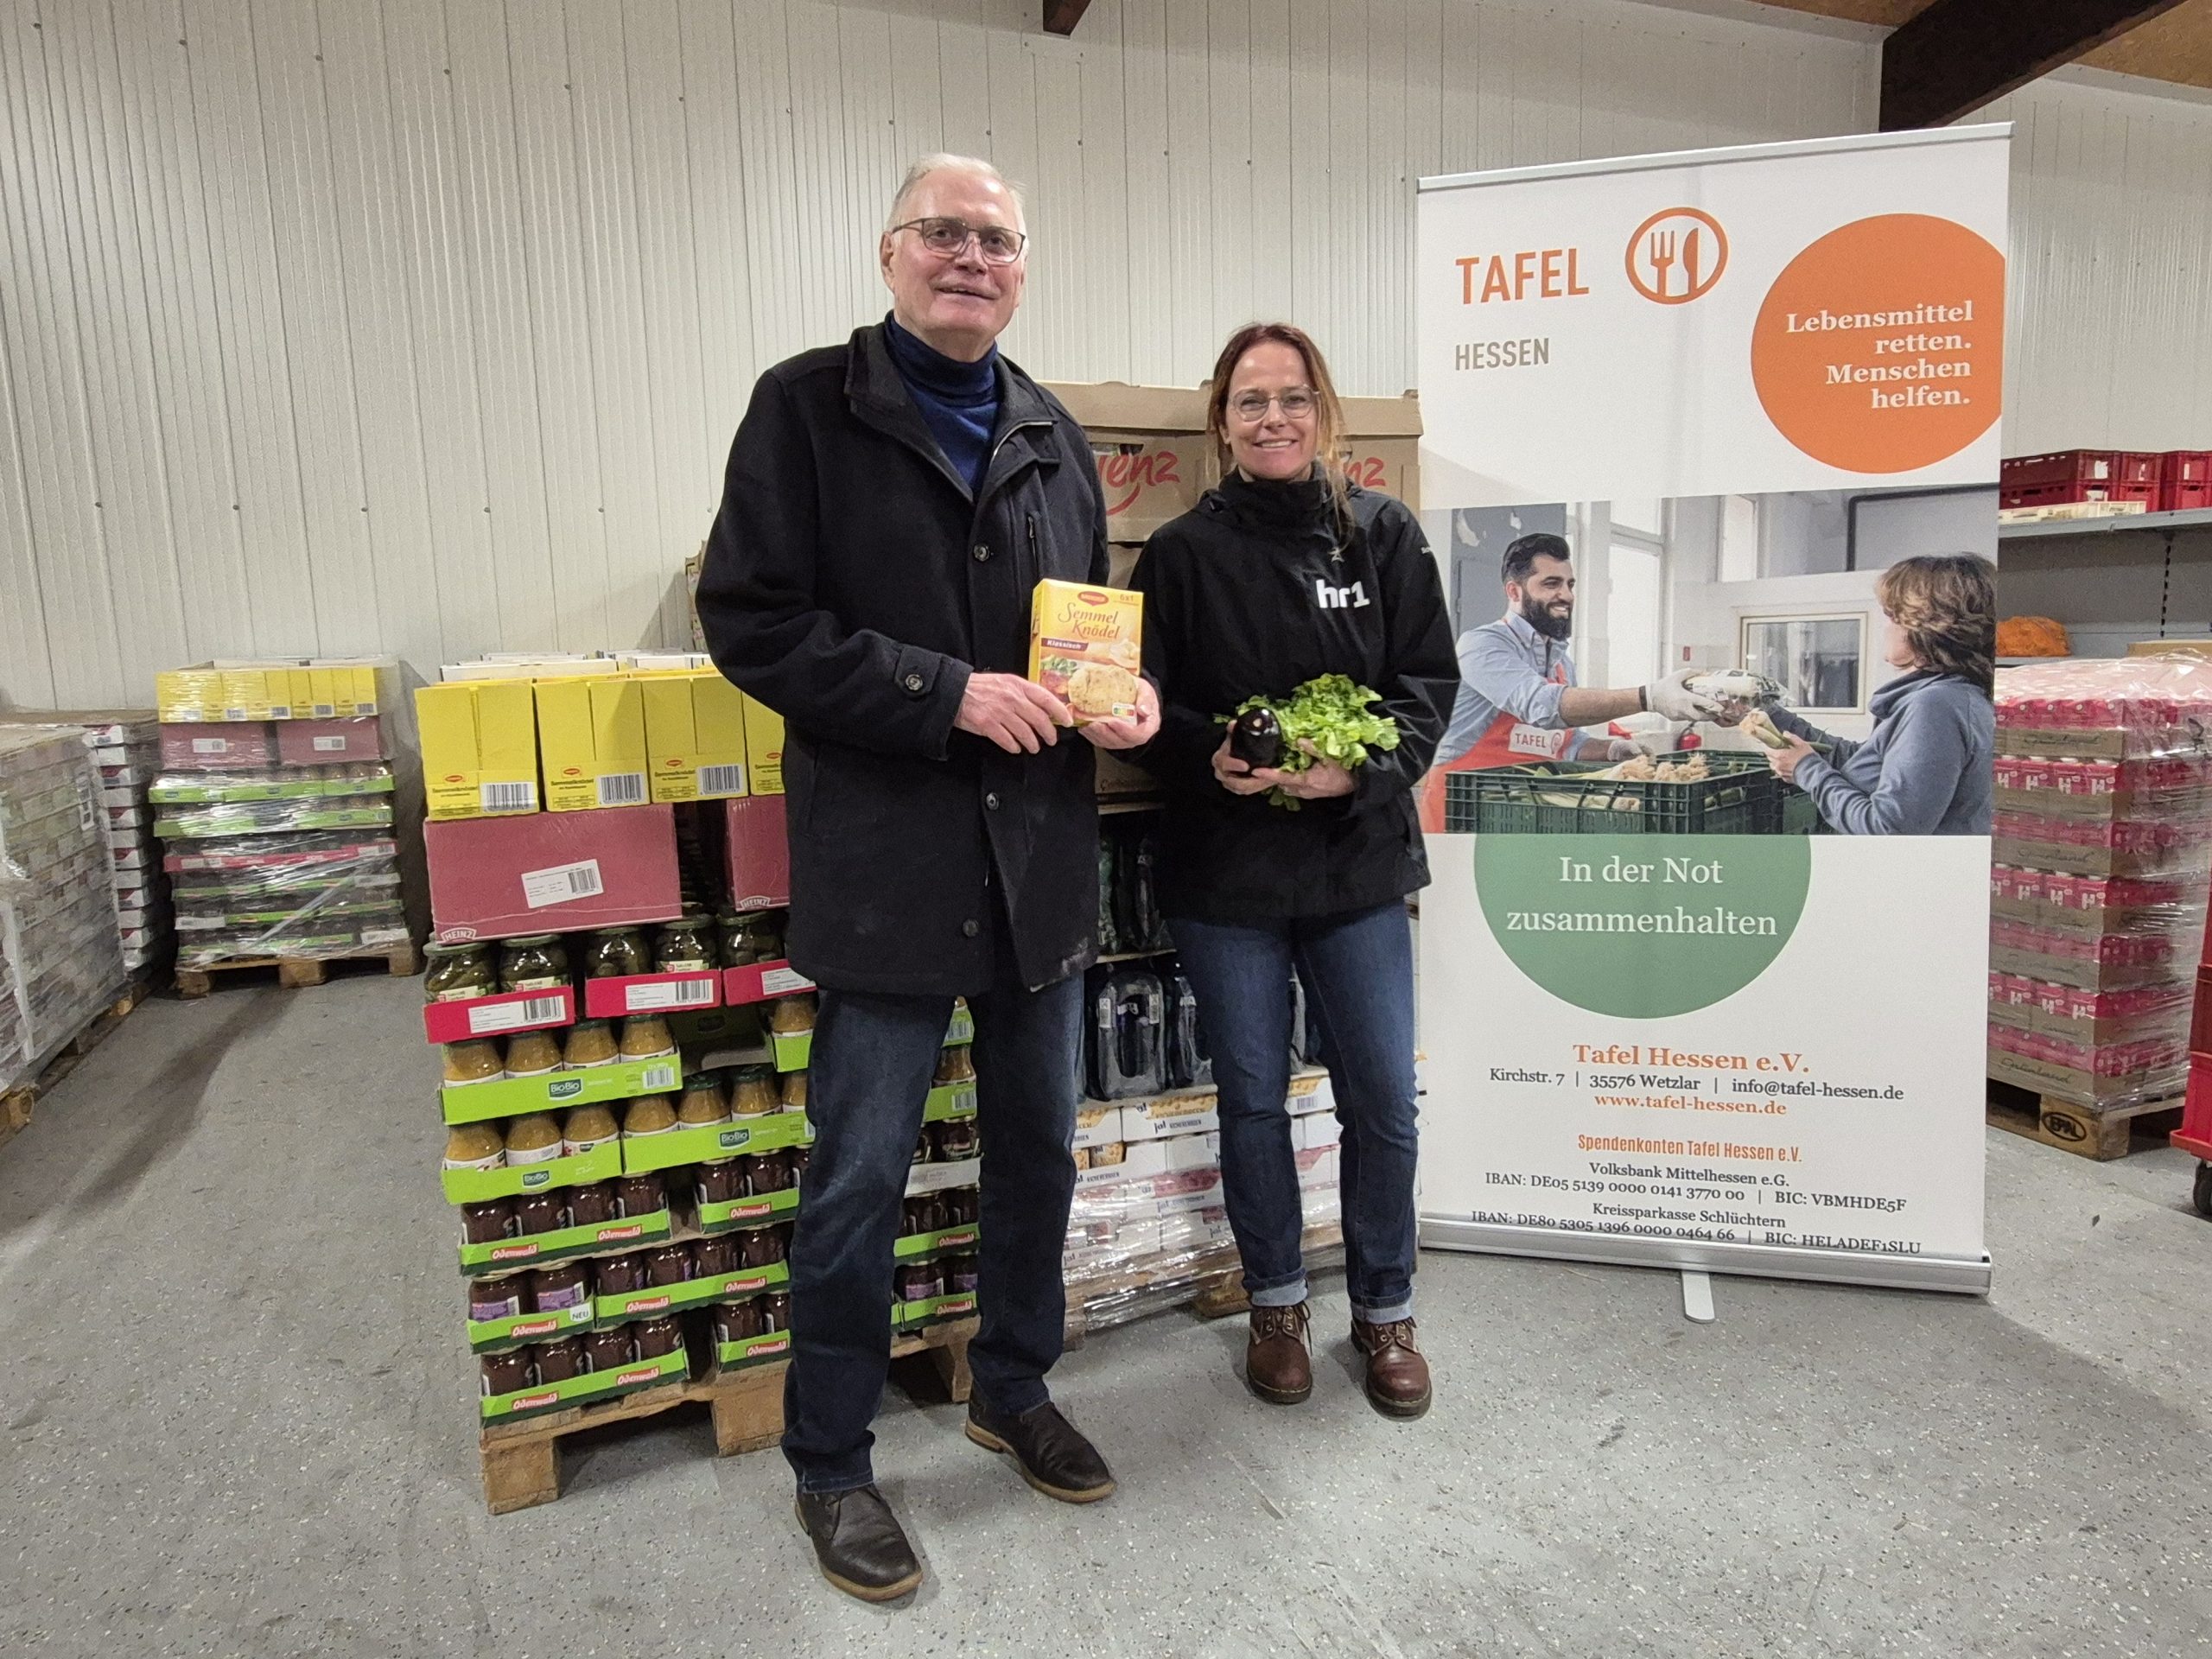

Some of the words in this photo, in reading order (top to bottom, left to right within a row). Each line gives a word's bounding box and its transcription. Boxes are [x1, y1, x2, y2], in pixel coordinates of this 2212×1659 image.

[1455, 248, 1590, 305] TAFEL
[1787, 300, 1974, 334] Lebensmittel
[1875, 331, 1972, 355] retten.
[1455, 337, 1550, 372] HESSEN
[1826, 358, 1972, 385] Menschen
[1872, 385, 1970, 410] helfen.
[1315, 579, 1370, 608] hr1
[1058, 602, 1119, 624] Semmel
[1072, 620, 1121, 639] Knödel
[1047, 639, 1082, 650] Klassisch
[1515, 733, 1546, 748] TAFEL
[1560, 856, 1592, 883] In
[1602, 855, 1654, 884] der
[1662, 858, 1723, 884] Not
[744, 898, 768, 906] HEINZ
[1506, 906, 1777, 937] zusammenhalten
[444, 931, 473, 941] HEINZ
[1573, 1045, 1640, 1065] Tafel
[1648, 1047, 1748, 1071] Hessen
[1756, 1053, 1810, 1073] e.V.
[1490, 1068, 1552, 1084] Kirchstr.
[1556, 1074, 1565, 1086] 7
[1589, 1074, 1636, 1090] 35576
[1639, 1074, 1700, 1090] Wetzlar
[1732, 1078, 1904, 1100] info@tafel-hessen.de
[1594, 1094, 1787, 1115] www.tafel-hessen.de
[1578, 1135, 1684, 1155] Spendenkonten
[1688, 1141, 1720, 1158] Tafel
[1724, 1142, 1774, 1161] Hessen
[1778, 1146, 1802, 1163] e.V.
[1589, 1162, 1662, 1179] Volksbank
[1666, 1166, 1758, 1185] Mittelhessen
[1761, 1173, 1790, 1187] e.G.
[1485, 1172, 1527, 1186] IBAN:
[1531, 1175, 1569, 1191] DE05
[1573, 1179, 1605, 1193] 5139
[1608, 1183, 1646, 1194] 0000
[1650, 1185, 1681, 1198] 0141
[1686, 1187, 1721, 1200] 3770
[1725, 1190, 1745, 1201] 00
[1775, 1192, 1808, 1205] BIC:
[1811, 1193, 1907, 1213] VBMHDE5F
[730, 1204, 770, 1217] Odenwald
[1592, 1203, 1696, 1223] Kreissparkasse
[1700, 1211, 1786, 1228] Schlüchtern
[598, 1225, 642, 1241] Odenwald
[1471, 1211, 1512, 1224] IBAN:
[1517, 1213, 1555, 1227] DE80
[1559, 1218, 1593, 1232] 5305
[1599, 1222, 1630, 1234] 1396
[1634, 1225, 1672, 1236] 0000
[1676, 1227, 1713, 1241] 0464
[1716, 1230, 1735, 1242] 66
[1765, 1231, 1797, 1246] BIC:
[1802, 1233, 1921, 1254] HELADEF1SLU
[492, 1243, 537, 1259] Odenwald
[726, 1278, 766, 1293] Odenwald
[572, 1310, 589, 1319] NEU
[626, 1299, 669, 1313] Odenwald
[512, 1321, 556, 1337] Odenwald
[747, 1341, 787, 1356] Odenwald
[618, 1368, 659, 1384] Odenwald
[513, 1393, 557, 1410] Odenwald
